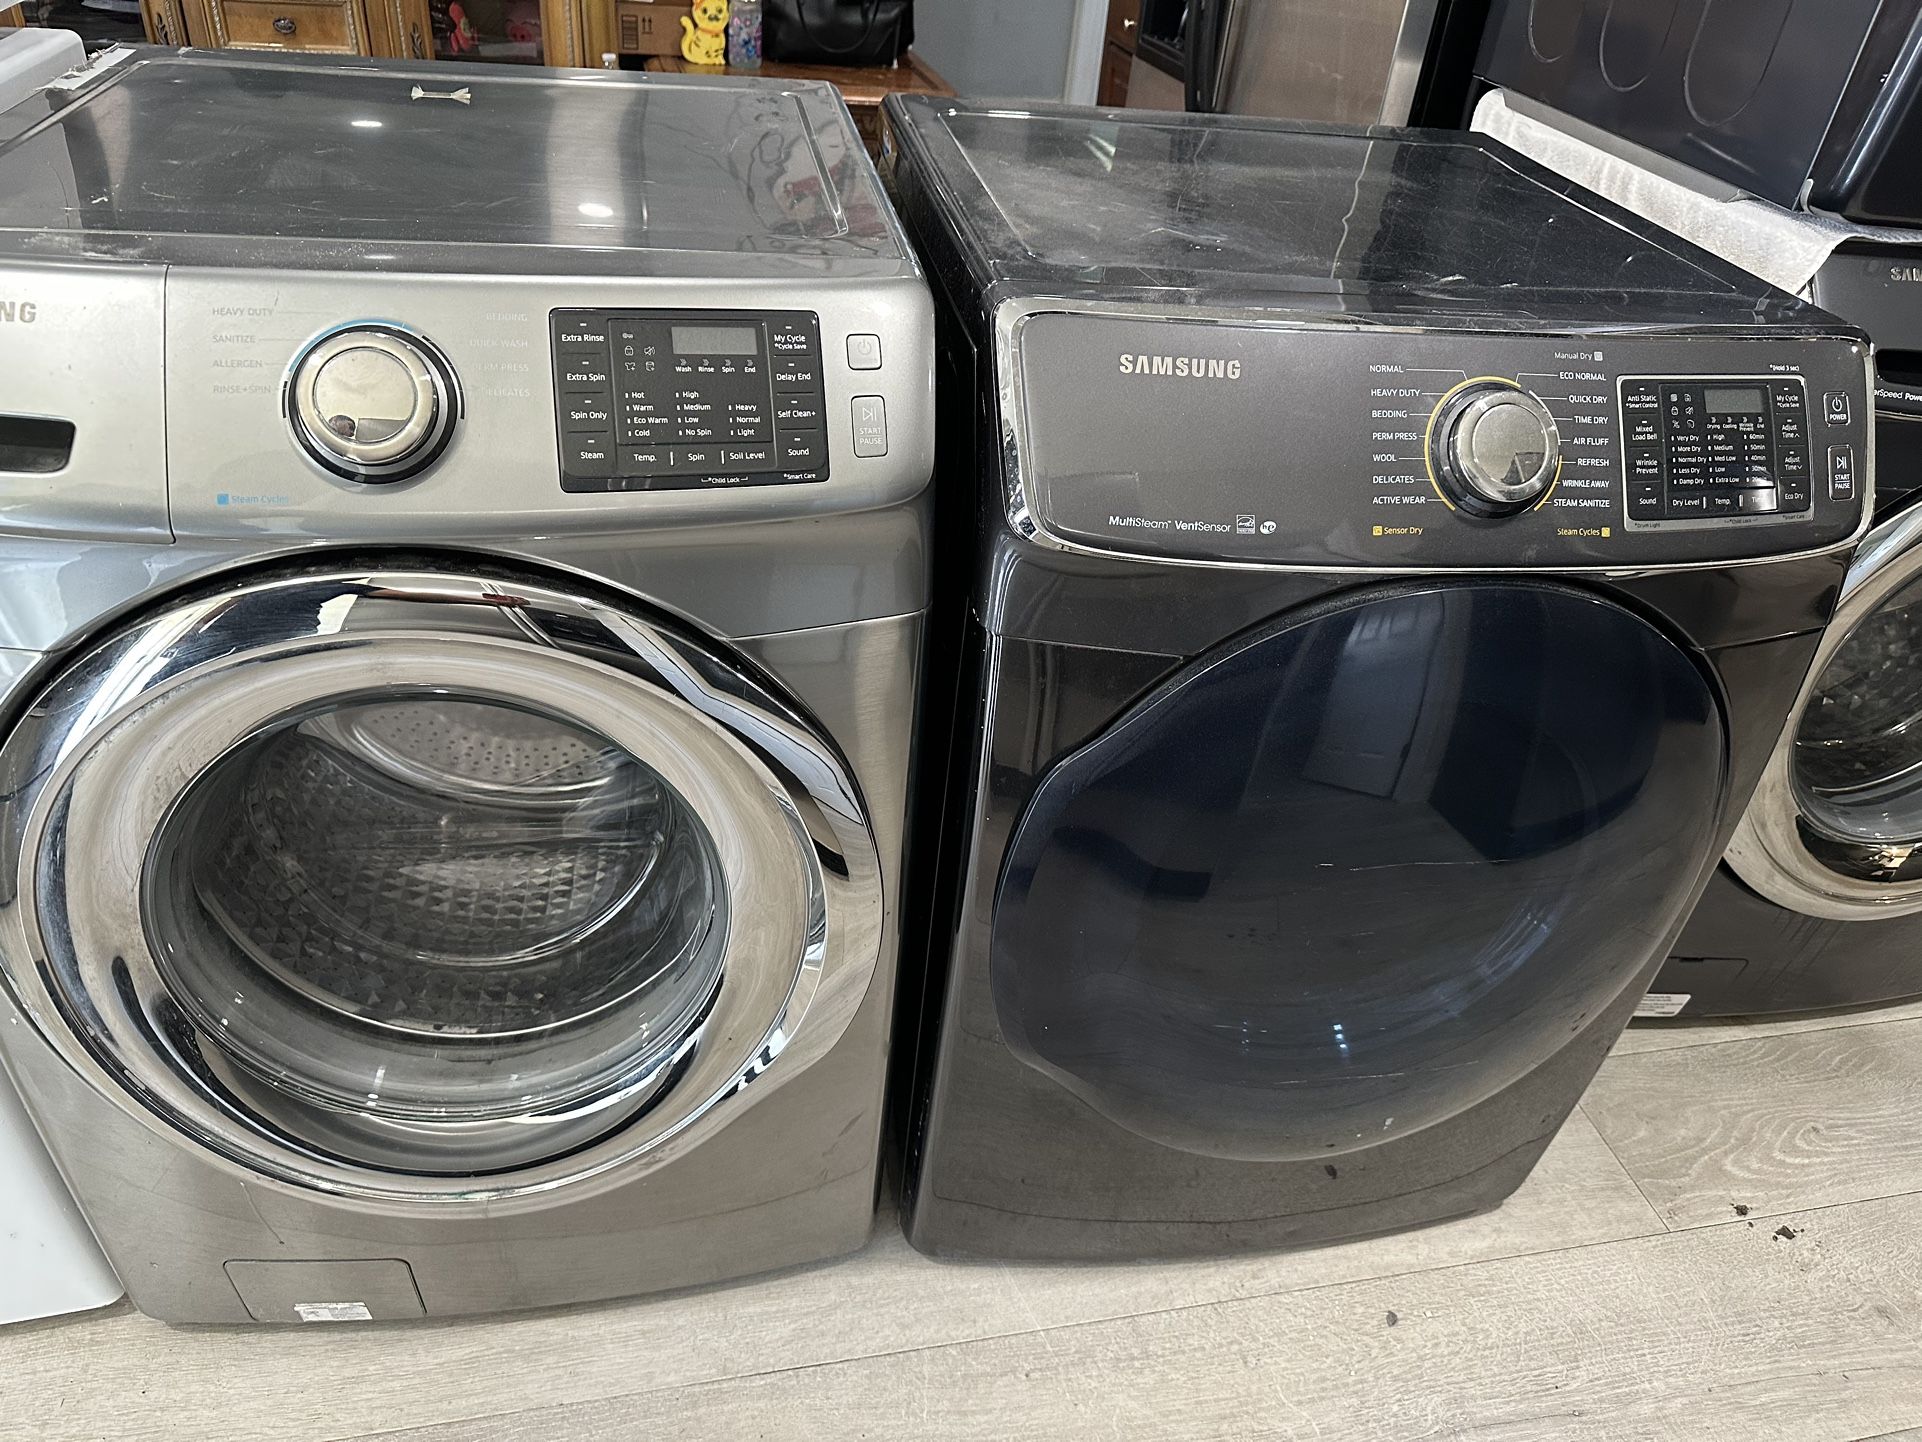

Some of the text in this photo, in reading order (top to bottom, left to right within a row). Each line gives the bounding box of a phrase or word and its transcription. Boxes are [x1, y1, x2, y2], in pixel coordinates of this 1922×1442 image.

[212, 307, 274, 316] HEAVY DUTY
[212, 334, 256, 343] SANITIZE
[562, 334, 605, 342] Extra Rinse
[774, 334, 806, 343] My Cycle
[1580, 352, 1592, 361] Dry
[212, 359, 263, 368] ALLERGEN
[1119, 353, 1241, 379] SAMSUNG
[721, 366, 735, 374] Spin
[1369, 364, 1404, 373] NORMAL
[566, 373, 606, 382] Extra Spin
[776, 373, 796, 382] Delay
[1560, 372, 1607, 381] ECO NORMAL
[213, 384, 271, 393] RINSE+SPIN
[1371, 388, 1421, 397] HEAVY DUTY
[682, 391, 699, 399] High
[1568, 395, 1608, 403] QUICK DRY
[1640, 394, 1657, 402] Static
[570, 411, 608, 420] Spin Only
[778, 410, 791, 418] Self
[1371, 410, 1408, 418] BEDDING
[1574, 415, 1609, 424] TIME DRY
[859, 427, 882, 435] START
[1782, 424, 1798, 432] Adjust
[697, 429, 712, 437] Spin
[737, 429, 755, 437] Light
[1372, 432, 1418, 440] PERM PRESS
[859, 437, 883, 445] PAUSE
[1573, 437, 1610, 446] AIR FLUFF
[580, 451, 604, 459] Steam
[729, 451, 765, 460] Soil Level
[788, 448, 810, 456] Sound
[634, 453, 657, 462] Temp.
[688, 453, 705, 462] Spin
[1372, 453, 1397, 462] WOOL
[1577, 458, 1610, 467] REFRESH
[1372, 475, 1415, 484] DELICATES
[1562, 480, 1610, 488] WRINKLE AWAY
[231, 495, 258, 504] Steam
[1372, 496, 1426, 505] ACTIVE WEAR
[1794, 492, 1803, 500] Dry
[1553, 499, 1610, 508] STEAM SANITIZE
[1175, 520, 1231, 533] VentSensor
[1384, 526, 1423, 536] Sensor Dry
[1557, 528, 1600, 536] Steam Cycles
